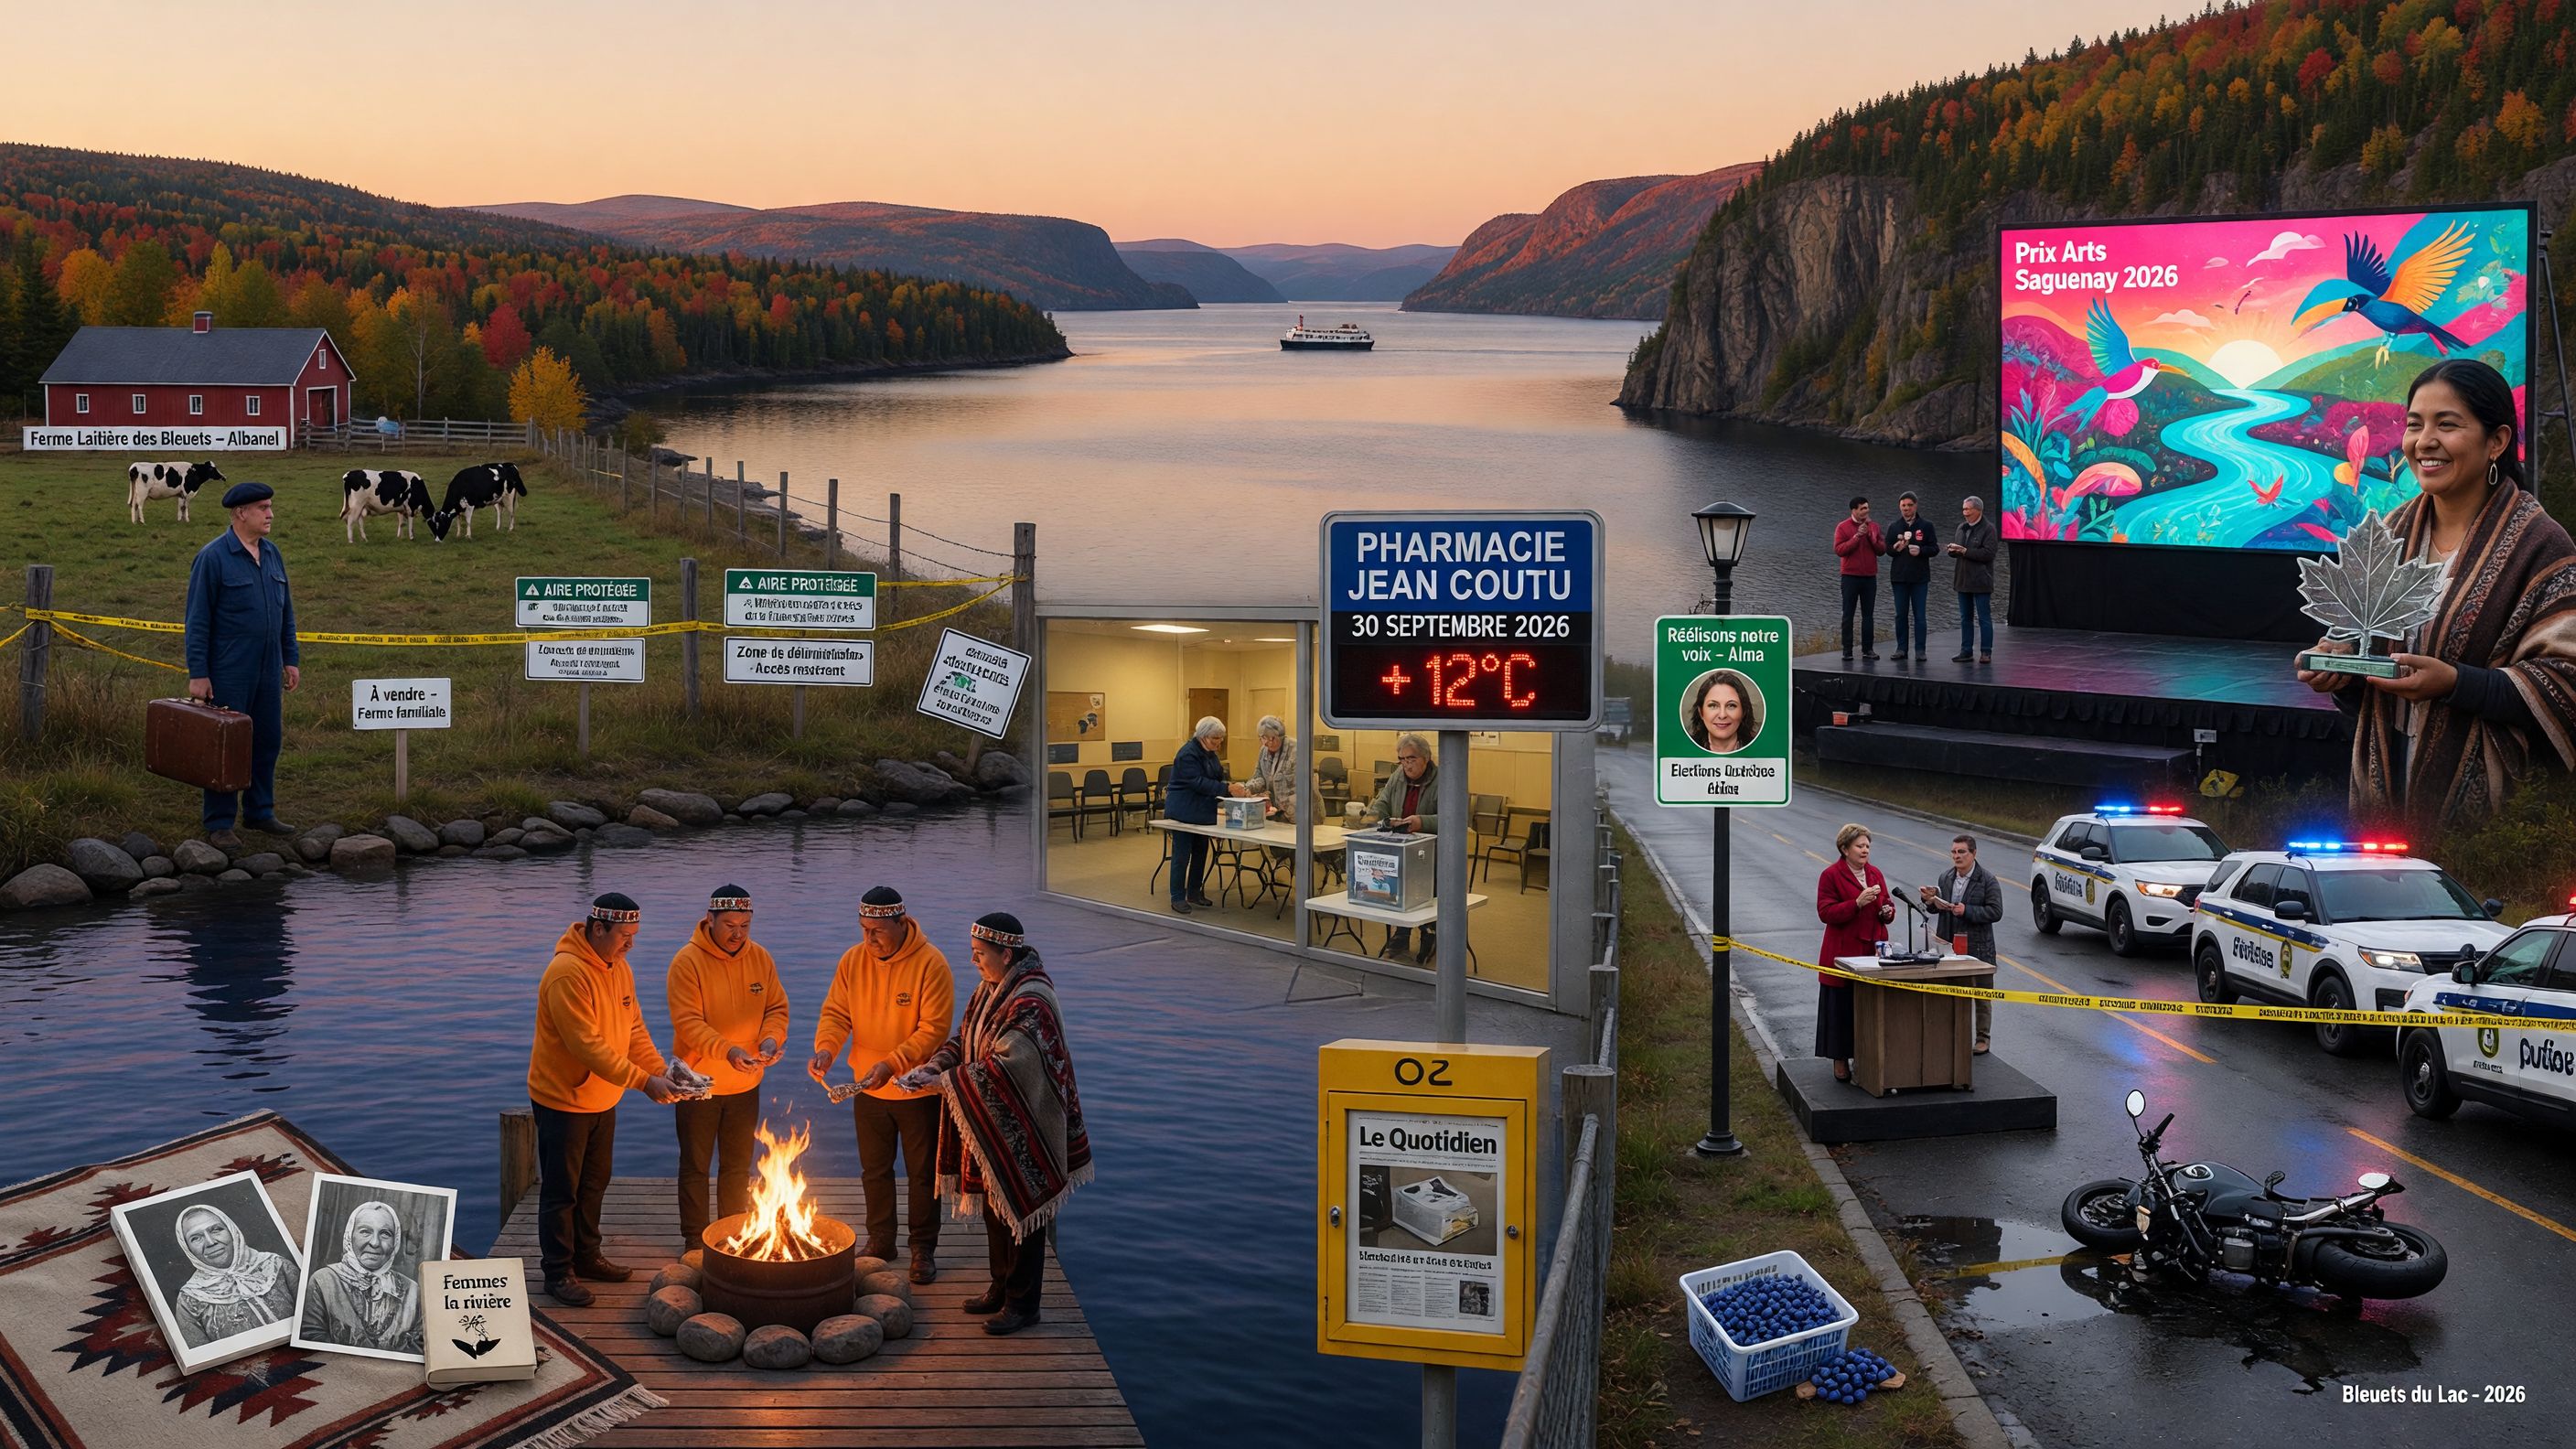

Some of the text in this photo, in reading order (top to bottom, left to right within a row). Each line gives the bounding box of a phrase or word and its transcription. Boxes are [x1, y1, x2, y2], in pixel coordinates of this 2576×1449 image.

[2015, 240, 2108, 264] Prix Arts
[2014, 264, 2179, 295] Saguenay 2026
[30, 431, 73, 446] Ferme
[77, 430, 129, 446] Laitière
[132, 430, 157, 446] des
[161, 430, 212, 446] Bleuets
[227, 430, 279, 446] Albanel
[1358, 531, 1566, 563] PHARMACIE
[757, 576, 788, 591] AIRE
[1347, 569, 1571, 601] JEAN COUTU
[1351, 614, 1570, 638] 30 SEPTEMBRE 2026
[1668, 626, 1779, 643] Réélisons notre
[736, 645, 767, 659] Zone
[1681, 646, 1712, 662] voix
[1728, 646, 1765, 662] Alma
[370, 684, 380, 703] À
[383, 686, 425, 702] vendre
[358, 707, 393, 720] Ferme
[1359, 1125, 1497, 1154] Le Quotidien
[443, 1274, 509, 1290] Femmes
[444, 1293, 511, 1310] la rivière
